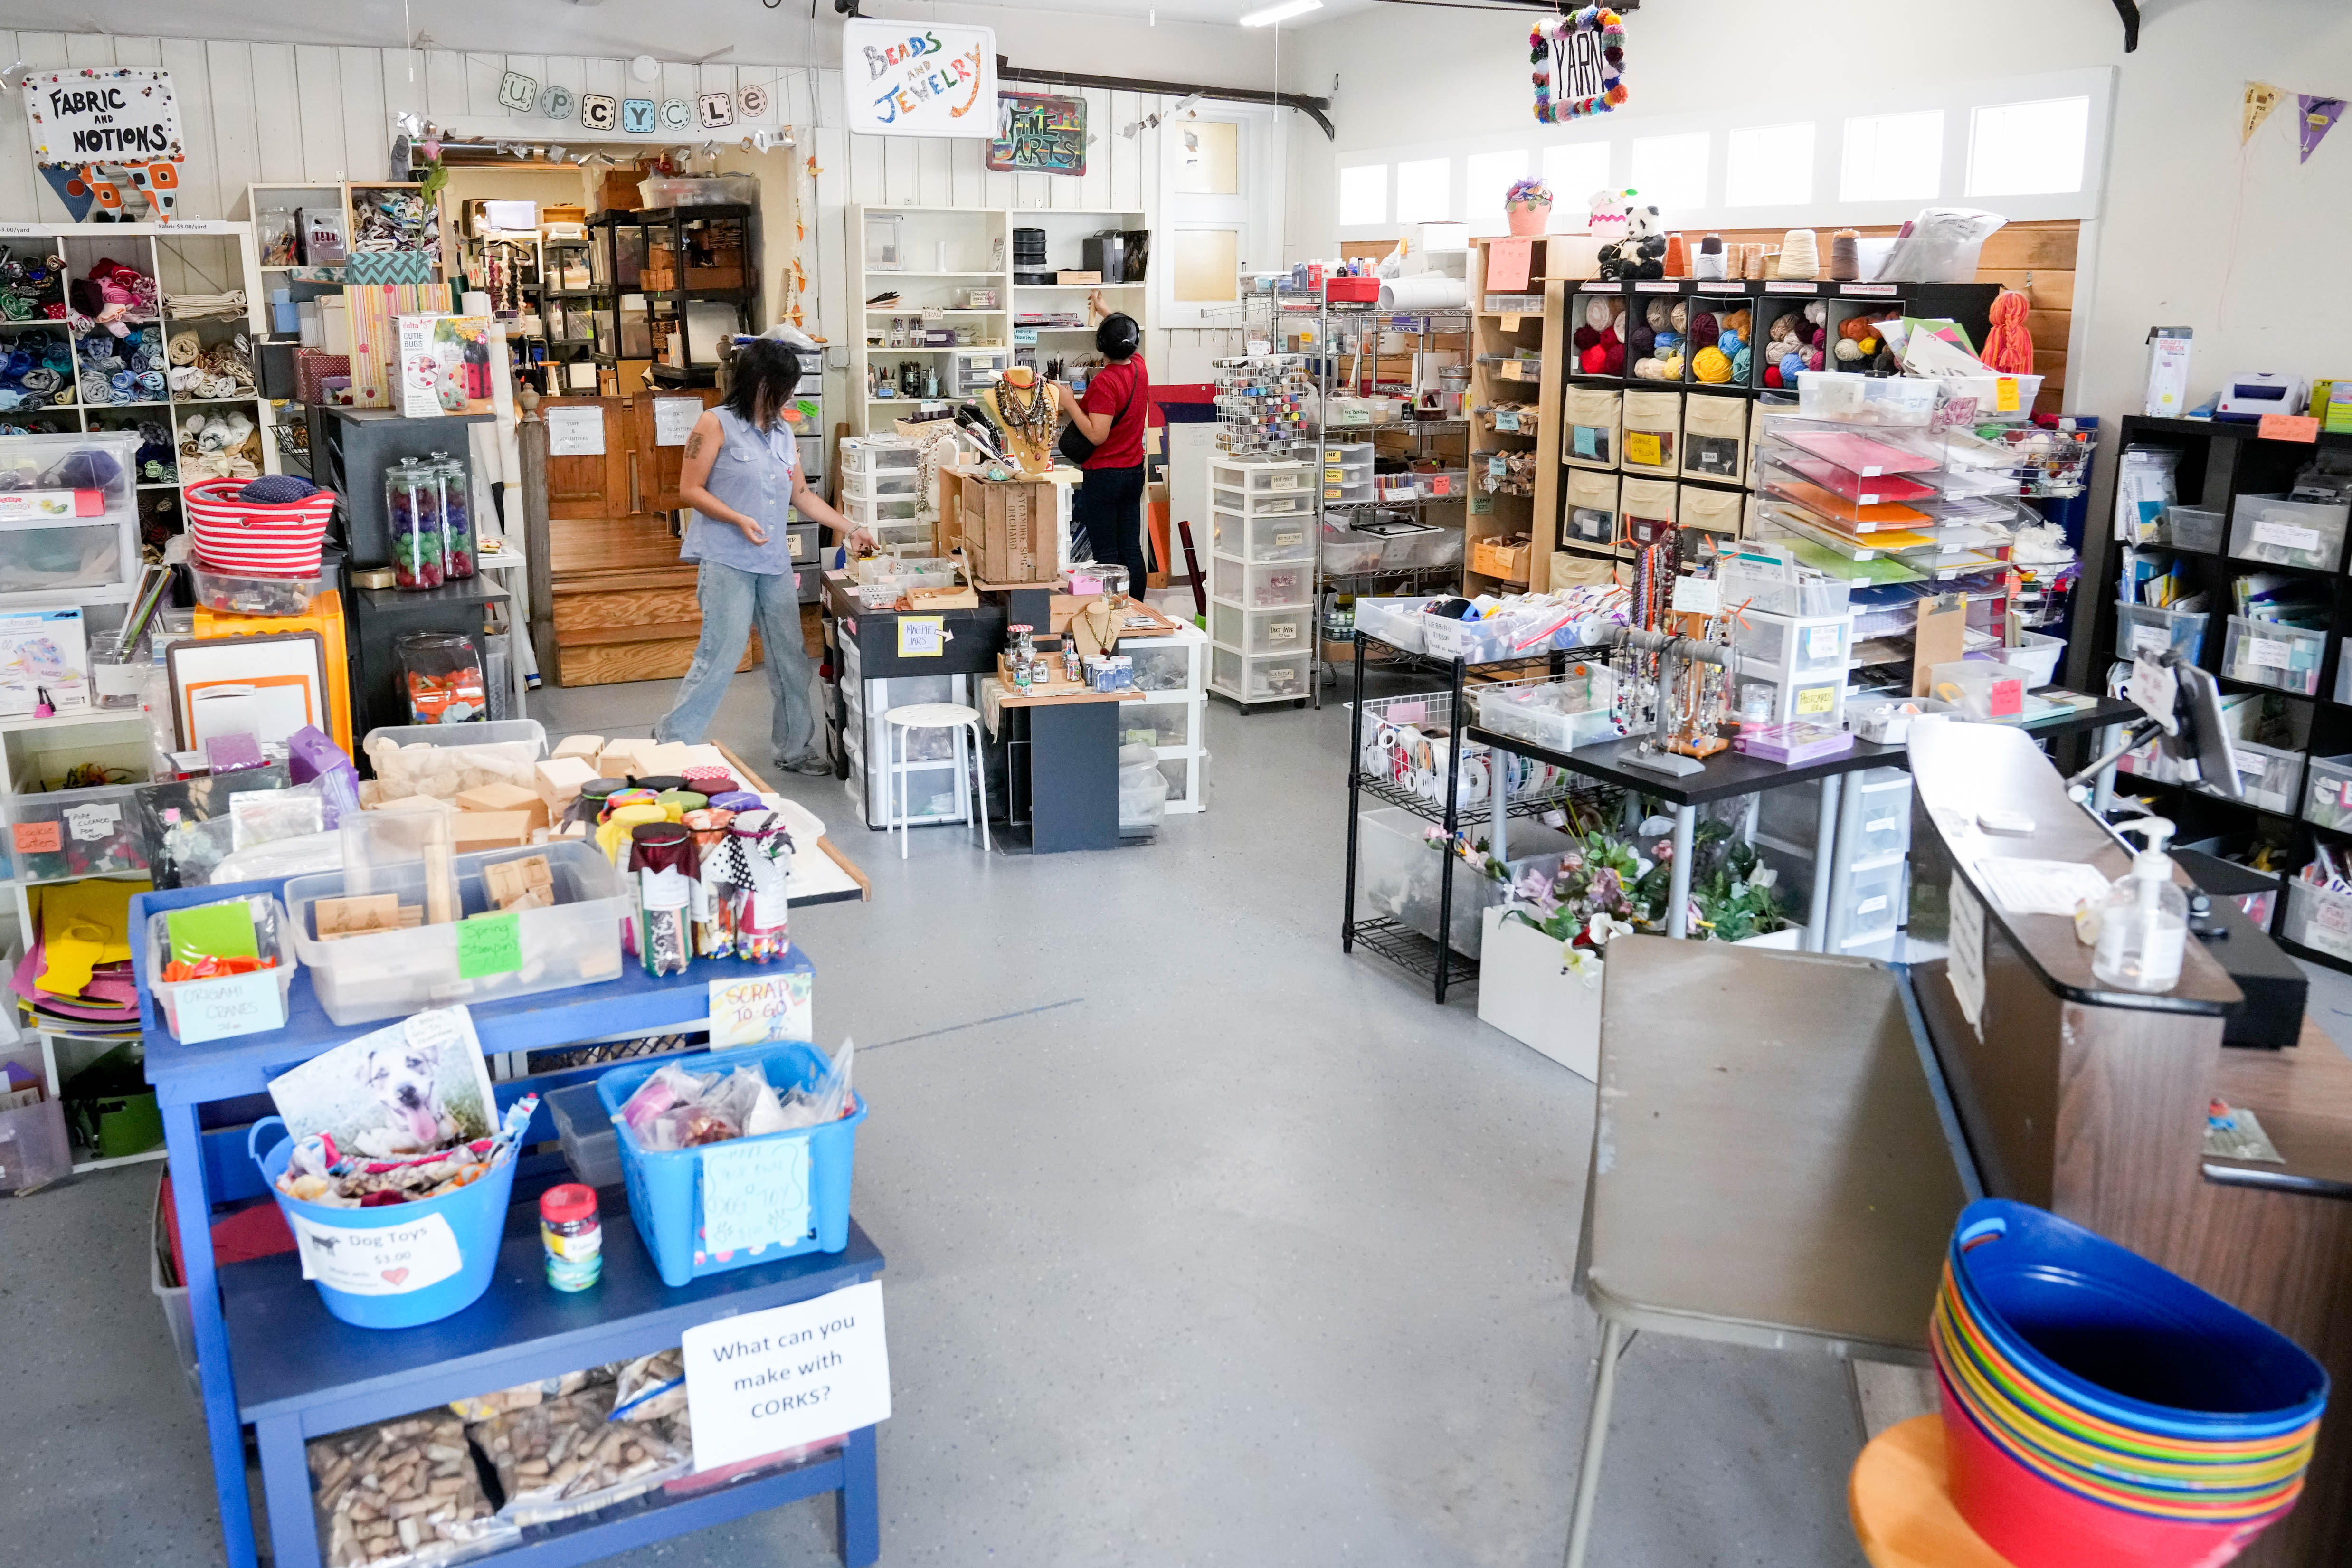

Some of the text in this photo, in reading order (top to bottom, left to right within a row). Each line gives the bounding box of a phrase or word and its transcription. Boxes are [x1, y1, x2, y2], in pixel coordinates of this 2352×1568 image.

[862, 30, 942, 87] BEADS
[907, 60, 931, 81] AND
[1553, 30, 1605, 99] YARN
[873, 41, 981, 124] JEWELRY
[49, 88, 126, 119] FABRIC
[95, 114, 114, 124] AND
[1009, 106, 1060, 138] FINE
[73, 124, 167, 152] NOTIONS
[1003, 137, 1078, 166] ARTS
[924, 311, 943, 319] DRAW
[1007, 505, 1017, 550] ORCHARD
[1018, 492, 1027, 542] SYCAMORE
[906, 624, 934, 635] MAGPIE
[907, 636, 927, 646] JARS
[80, 696, 85, 704] 1
[1800, 692, 1833, 704] POSTCARDS
[463, 924, 510, 941] Spring
[183, 984, 244, 1005] ORIGAMI
[725, 978, 790, 1005] SCRAP
[206, 1001, 259, 1021] CRANES
[349, 1226, 428, 1249] Dog Toys
[374, 1250, 412, 1265] $3.00
[712, 1314, 856, 1363] What can you
[733, 1350, 843, 1392] make with
[750, 1384, 832, 1419] CORKS?
